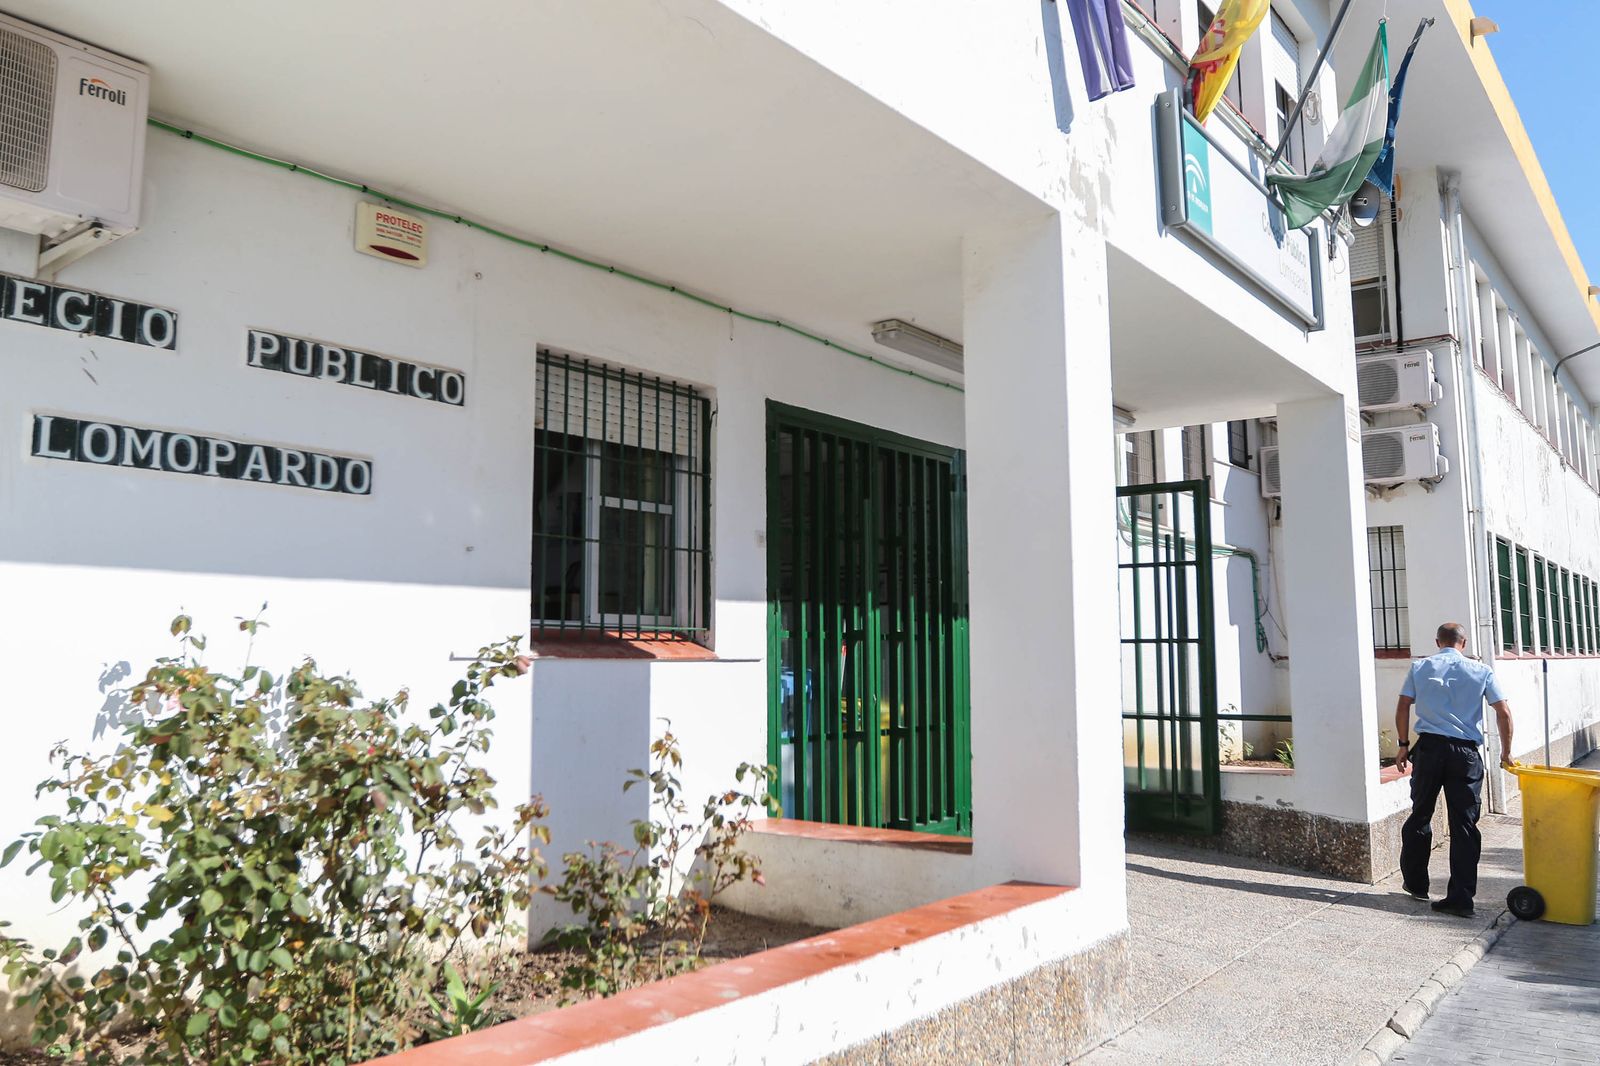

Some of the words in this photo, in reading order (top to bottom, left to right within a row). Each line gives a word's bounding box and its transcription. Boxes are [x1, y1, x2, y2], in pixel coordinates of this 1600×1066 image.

[79, 77, 126, 106] Ferroli
[375, 211, 424, 234] PROTELEC
[9, 278, 174, 349] EGIO
[250, 332, 465, 407] PUBLICO
[36, 415, 371, 495] LOMOPARDO
